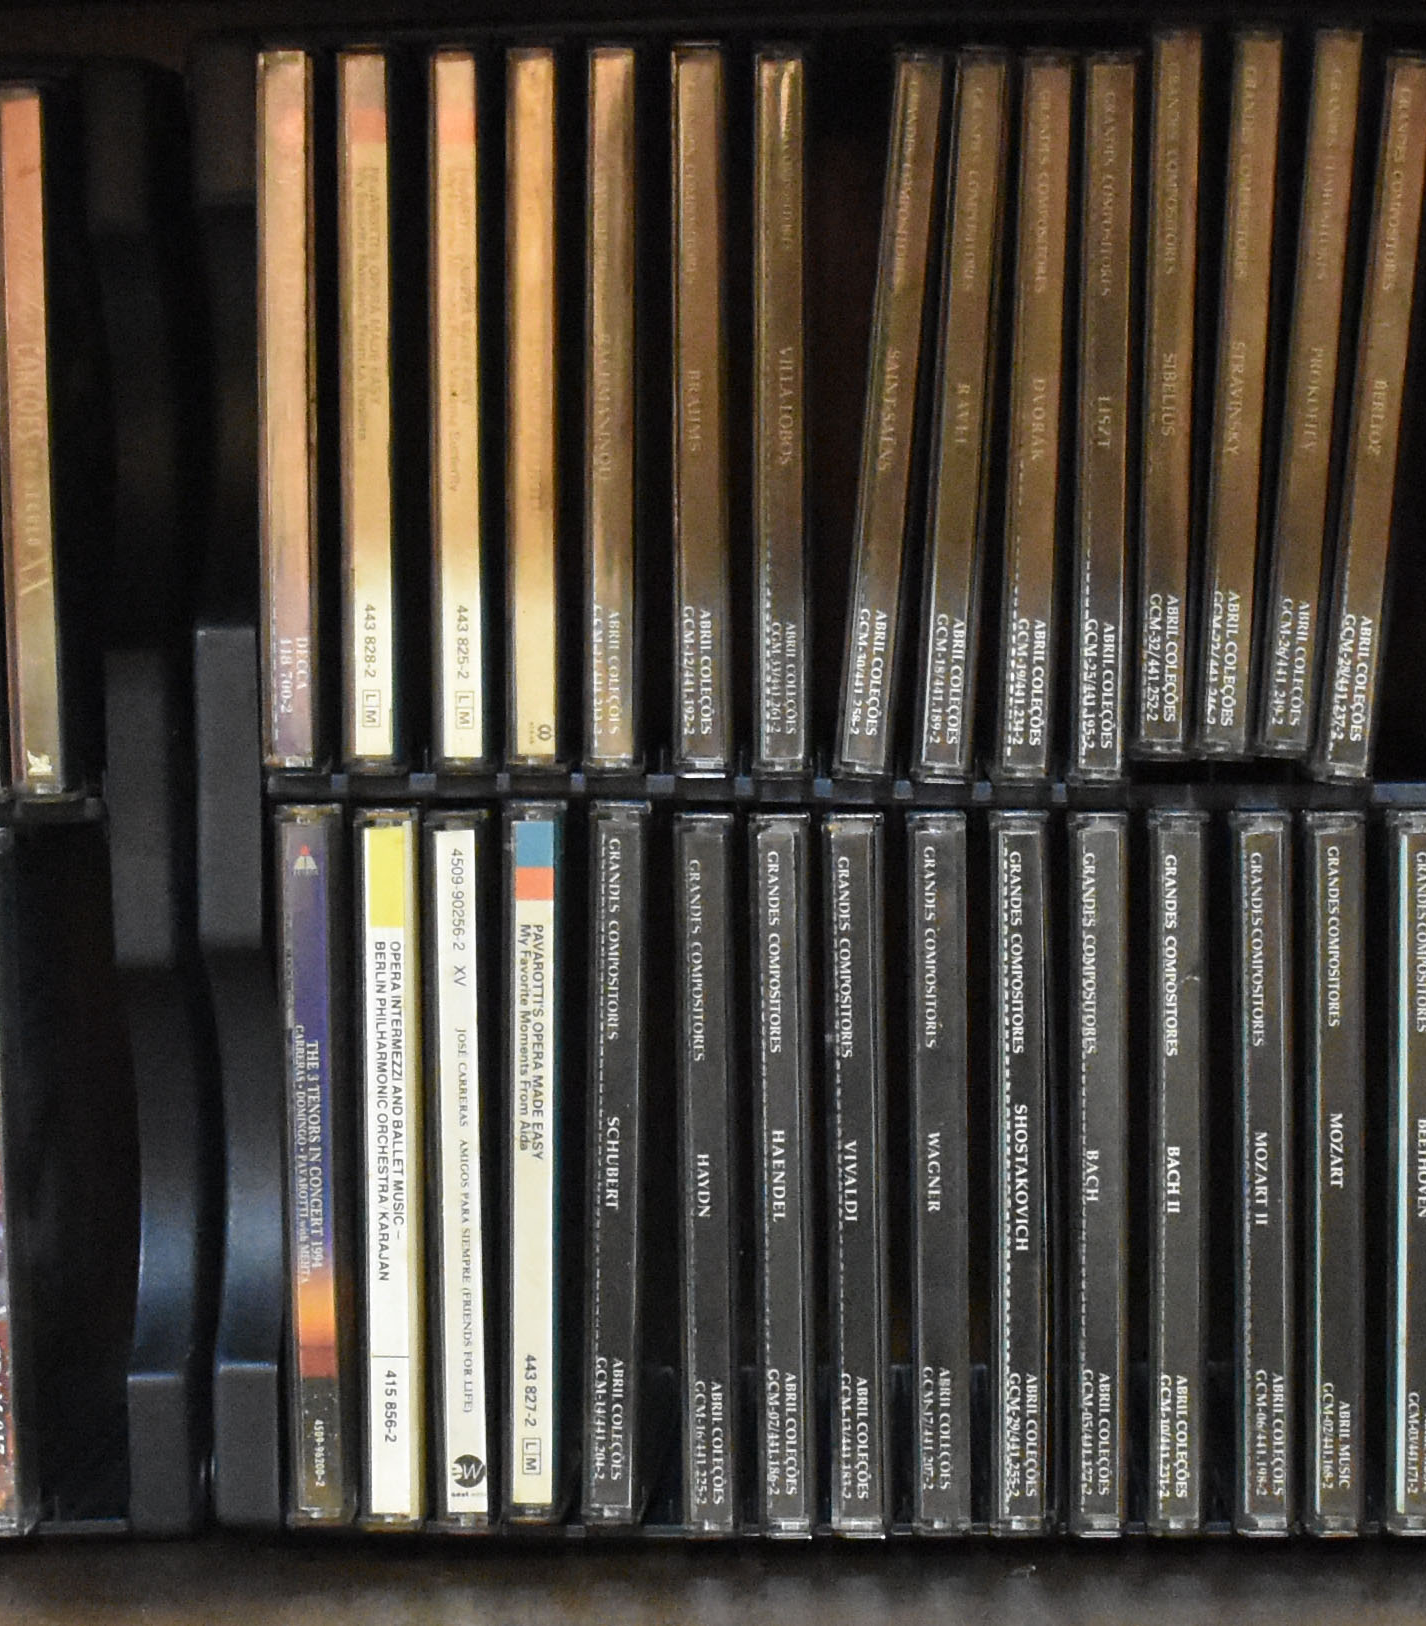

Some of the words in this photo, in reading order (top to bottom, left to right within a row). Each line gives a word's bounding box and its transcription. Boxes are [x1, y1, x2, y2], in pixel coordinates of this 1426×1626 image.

[364, 604, 376, 631] 443
[456, 605, 469, 633] 443
[699, 609, 712, 653] ABRIL
[1165, 595, 1180, 639] ABRIL
[363, 636, 377, 678] 828-2
[456, 638, 470, 679] 825-2
[1160, 641, 1179, 722] COLEÇÕES
[696, 656, 714, 734] COLEÇÕES
[451, 849, 466, 951] 4509-90256-2
[767, 851, 780, 925] GRANDES
[1009, 851, 1023, 926] GRANDES
[1327, 846, 1340, 913] GRANDES
[518, 924, 531, 946] My
[375, 941, 387, 994] BERLIN
[389, 941, 402, 991] OPERA
[452, 965, 467, 986] XV
[519, 950, 531, 1006] Favorite
[531, 924, 544, 1016] PAVAROTTI'S
[1327, 916, 1340, 1027] COMPOSITORES
[768, 933, 781, 1054] COMPOSITORES
[1010, 933, 1024, 1054] COMPOSITORES
[375, 998, 389, 1109] PHILHARMONIC
[390, 995, 402, 1082] INTERMEZZI
[519, 1011, 531, 1076] Moments
[531, 1022, 544, 1070] OPERA
[391, 1086, 403, 1116] AND
[520, 1080, 531, 1115] From
[531, 1075, 544, 1117] MADE
[392, 1120, 404, 1177] BALLET
[519, 1120, 531, 1151] Aida
[531, 1122, 544, 1161] EASY
[1329, 1113, 1343, 1188] MOZART
[605, 1115, 620, 1210] SCHUBERT
[696, 1153, 711, 1218] HAYDN
[771, 1130, 786, 1222] HAENDEL
[843, 1139, 857, 1222] VIVALDI
[927, 1132, 941, 1212] WAGNER
[1014, 1103, 1028, 1251] SHOSTAKOVICH
[1085, 1150, 1100, 1202] BACH
[1166, 1146, 1180, 1196] BACH
[1254, 1131, 1268, 1209] MOZART
[392, 1180, 404, 1226] MUSIC
[1167, 1200, 1180, 1213] II
[1254, 1212, 1268, 1225] II
[384, 1370, 396, 1396] 415
[525, 1355, 537, 1381] 443
[384, 1401, 396, 1443] 856-2
[524, 1385, 537, 1427] 827-2
